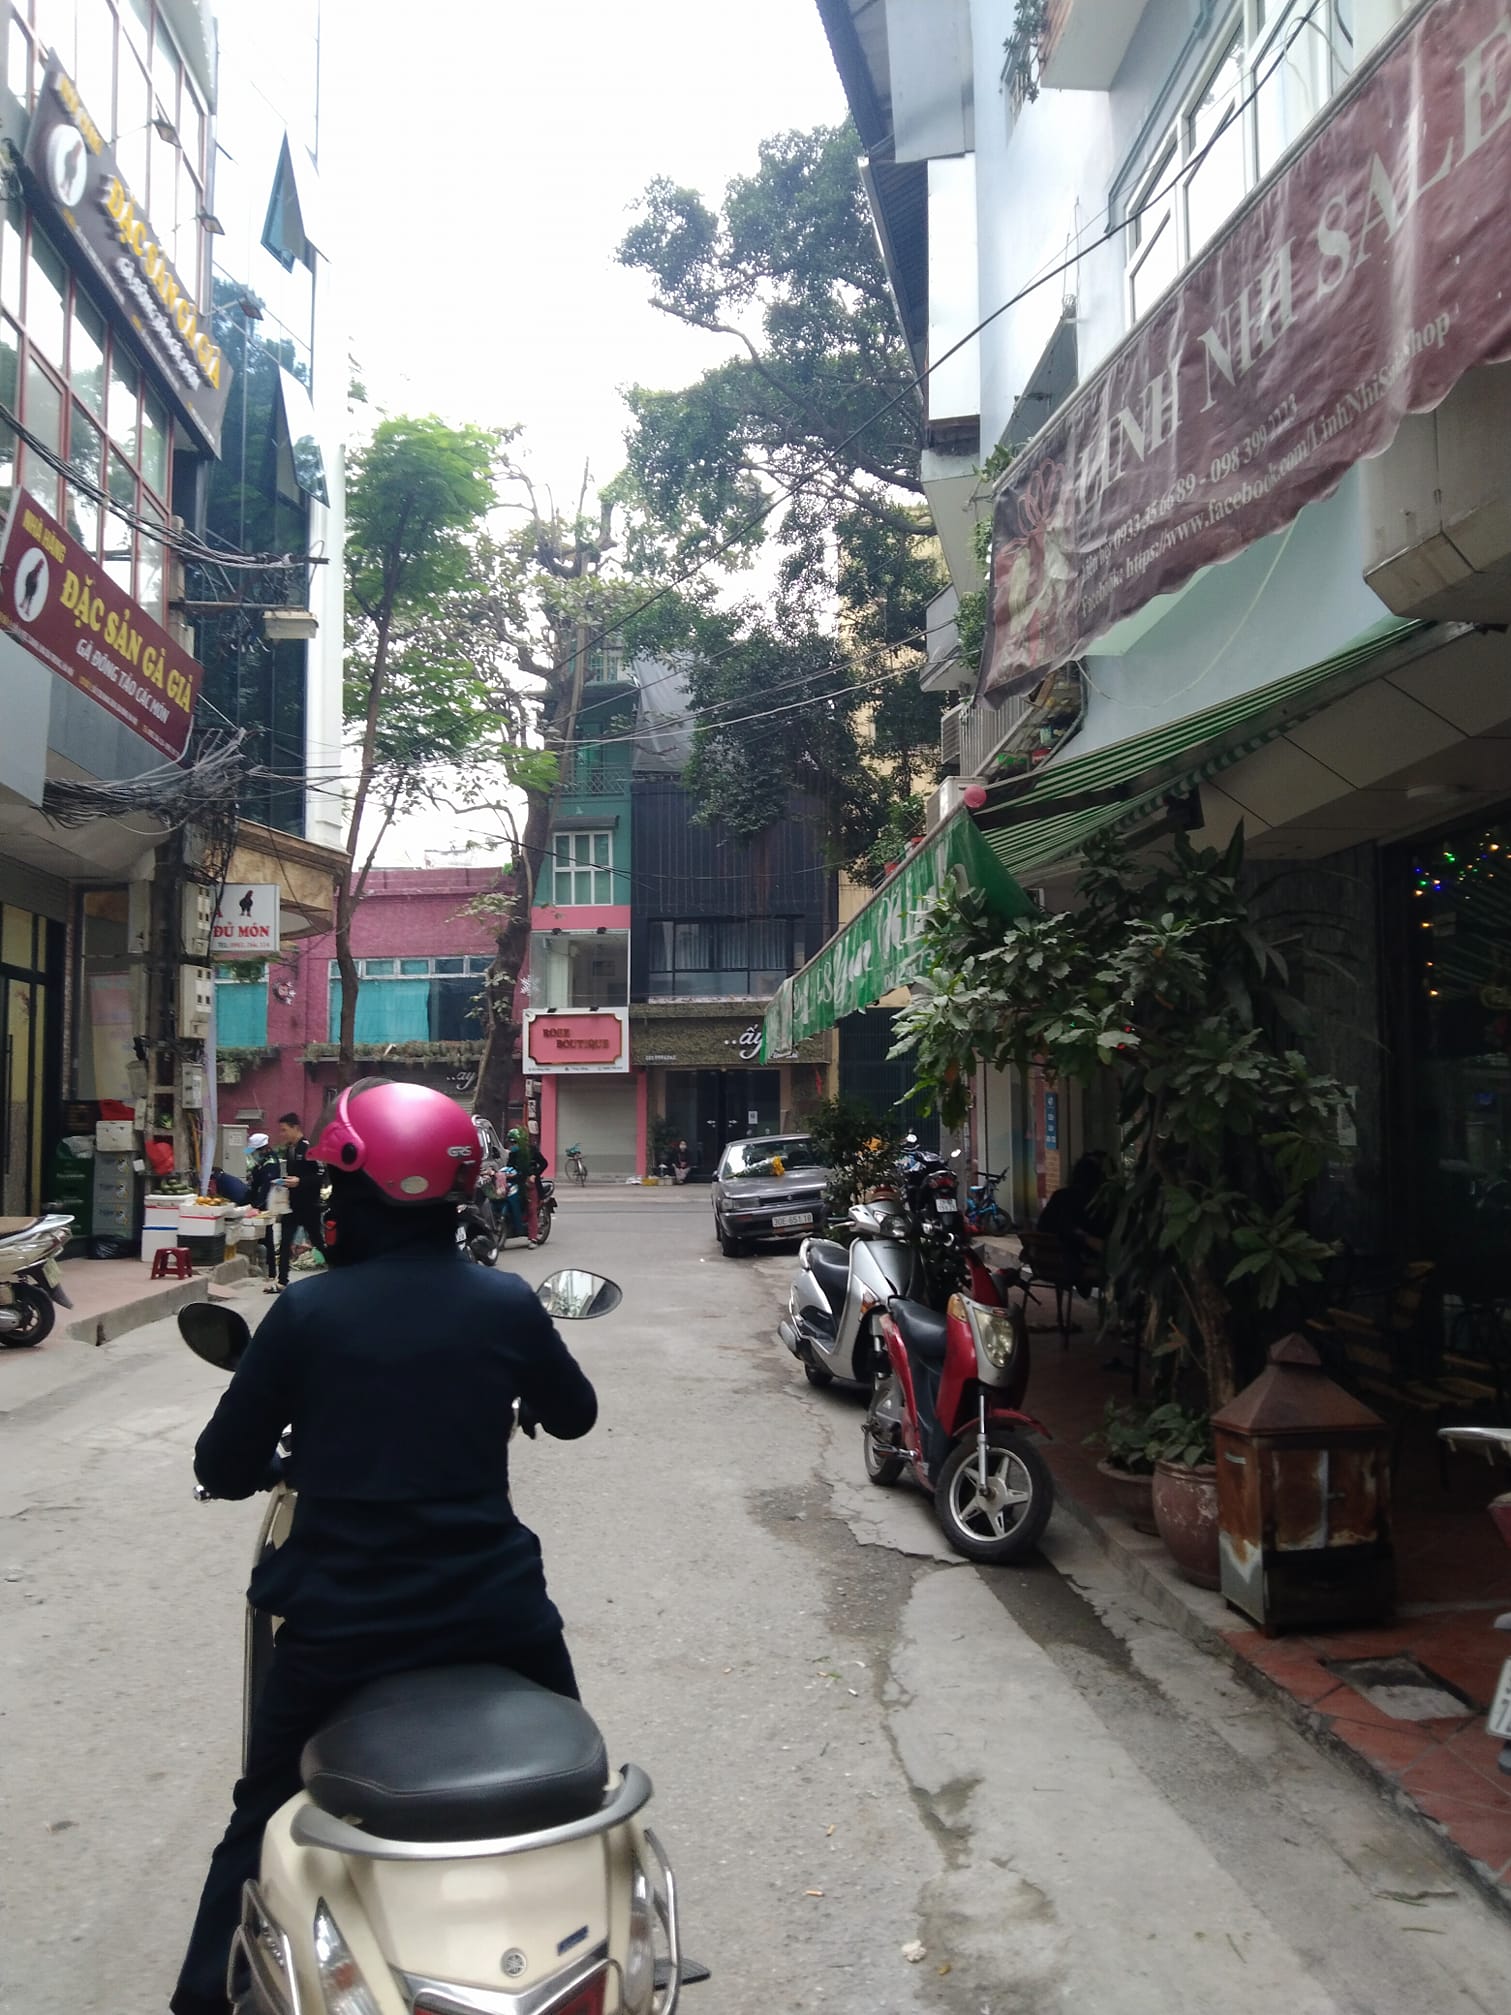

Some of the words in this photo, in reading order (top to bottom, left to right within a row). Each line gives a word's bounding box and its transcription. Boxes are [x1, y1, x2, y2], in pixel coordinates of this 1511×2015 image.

[1076, 337, 1185, 518] LINH
[1197, 236, 1298, 413] NHI
[1317, 12, 1511, 303] SALE
[60, 569, 105, 632] ĐẶC
[104, 608, 143, 666] SẢN
[142, 647, 166, 689] GÀ
[167, 669, 193, 713] GIÀ
